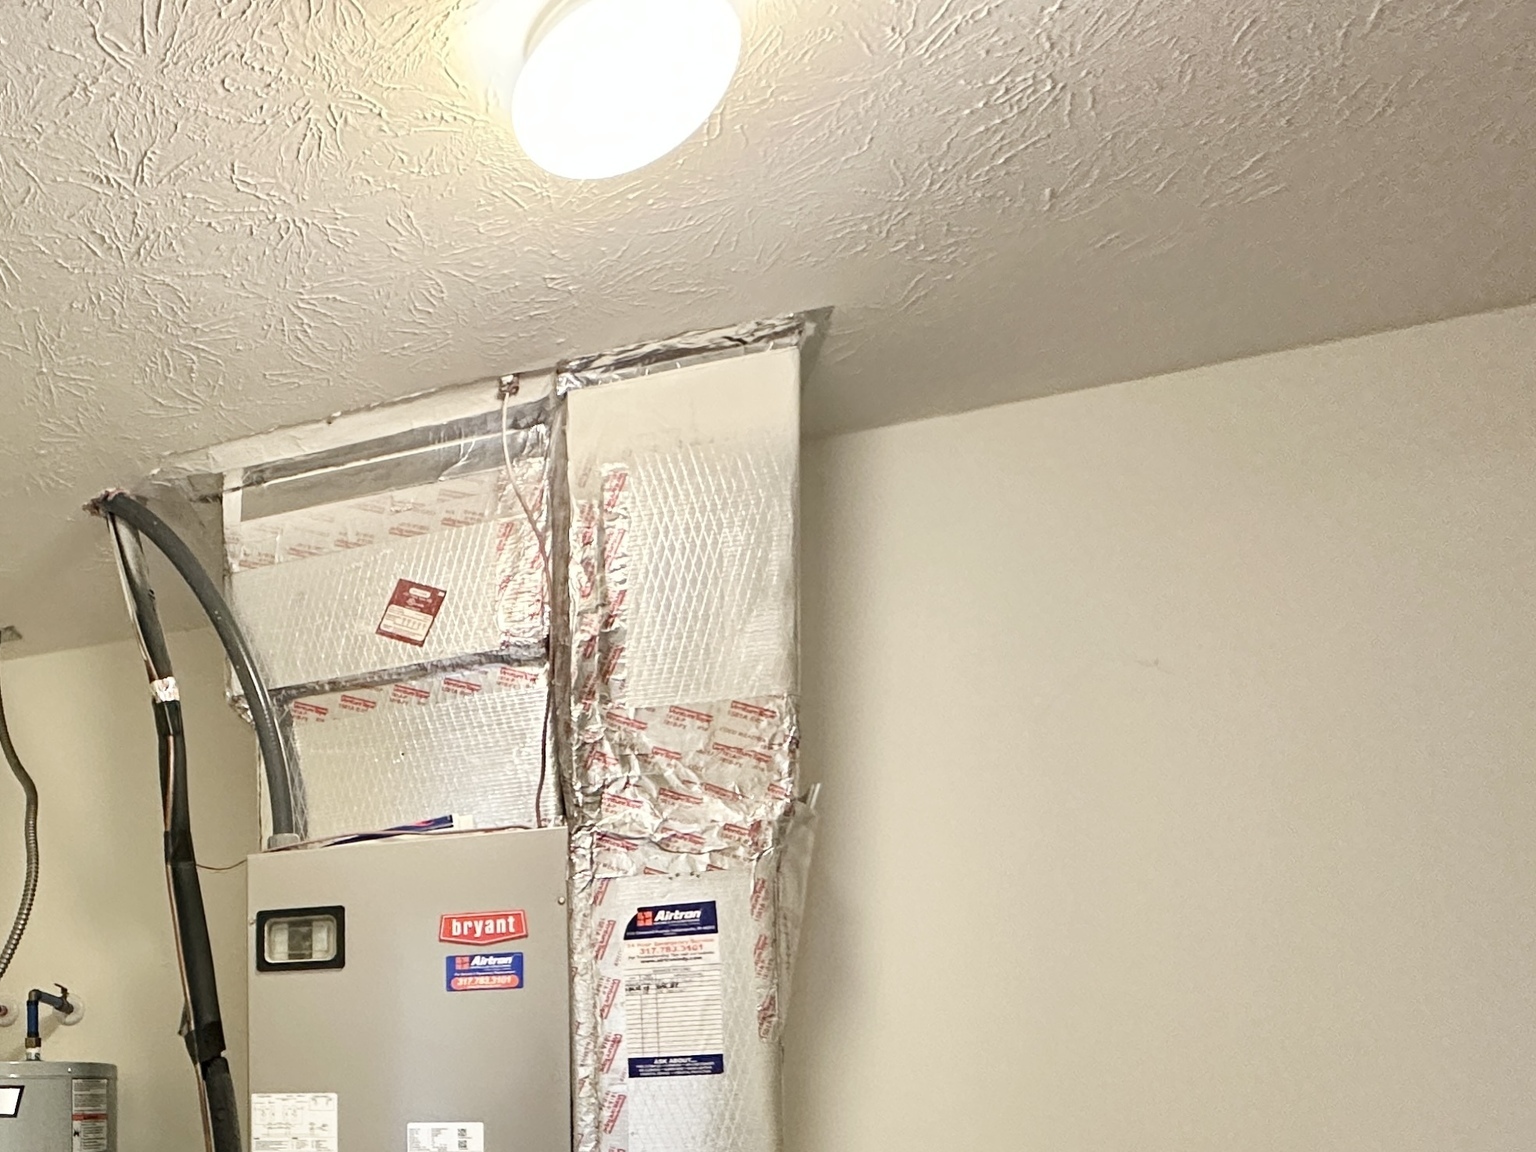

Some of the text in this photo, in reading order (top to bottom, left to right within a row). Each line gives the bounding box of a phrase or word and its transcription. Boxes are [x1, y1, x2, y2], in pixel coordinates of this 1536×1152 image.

[654, 910, 701, 922] Airtron
[452, 916, 515, 938] bryant
[471, 955, 513, 966] Airtron
